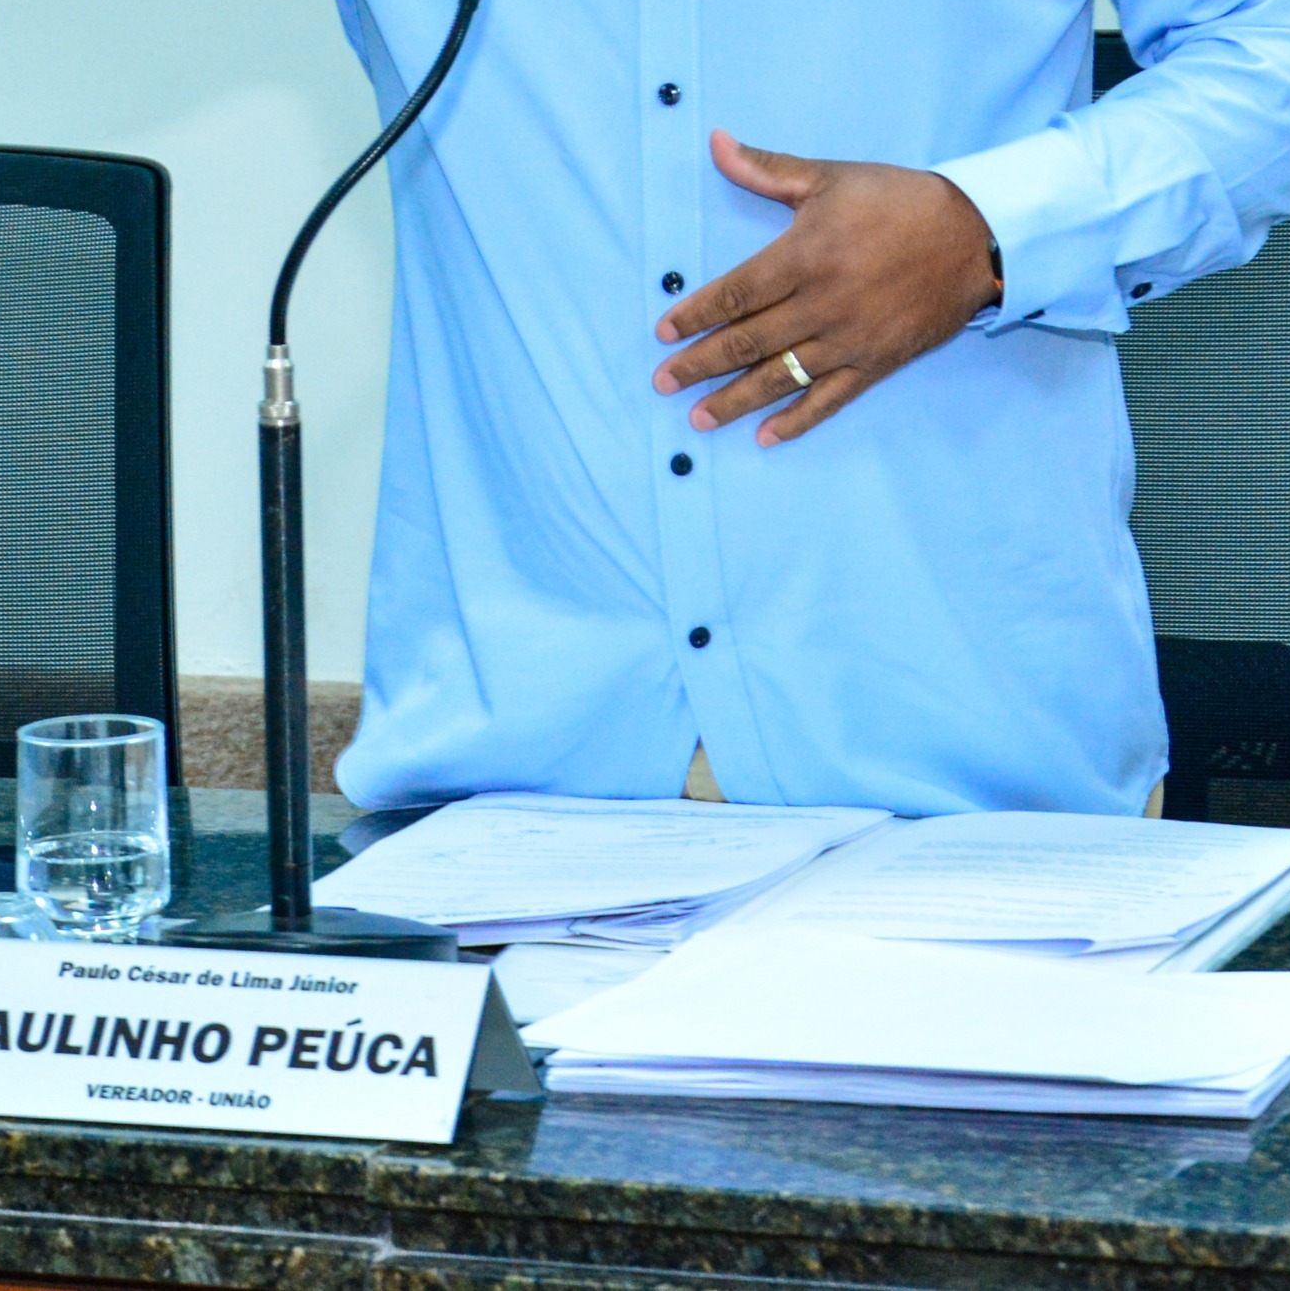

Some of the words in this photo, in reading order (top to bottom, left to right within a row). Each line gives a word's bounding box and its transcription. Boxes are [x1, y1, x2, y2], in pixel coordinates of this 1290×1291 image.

[59, 961, 121, 981] Paulo
[127, 964, 191, 985] César
[196, 969, 223, 986] de
[230, 971, 283, 990] Lima
[288, 974, 358, 995] Júnior
[248, 1017, 439, 1078] PEÚCA
[86, 1083, 193, 1105] VEREADOR
[209, 1089, 272, 1110] UNIÃO
